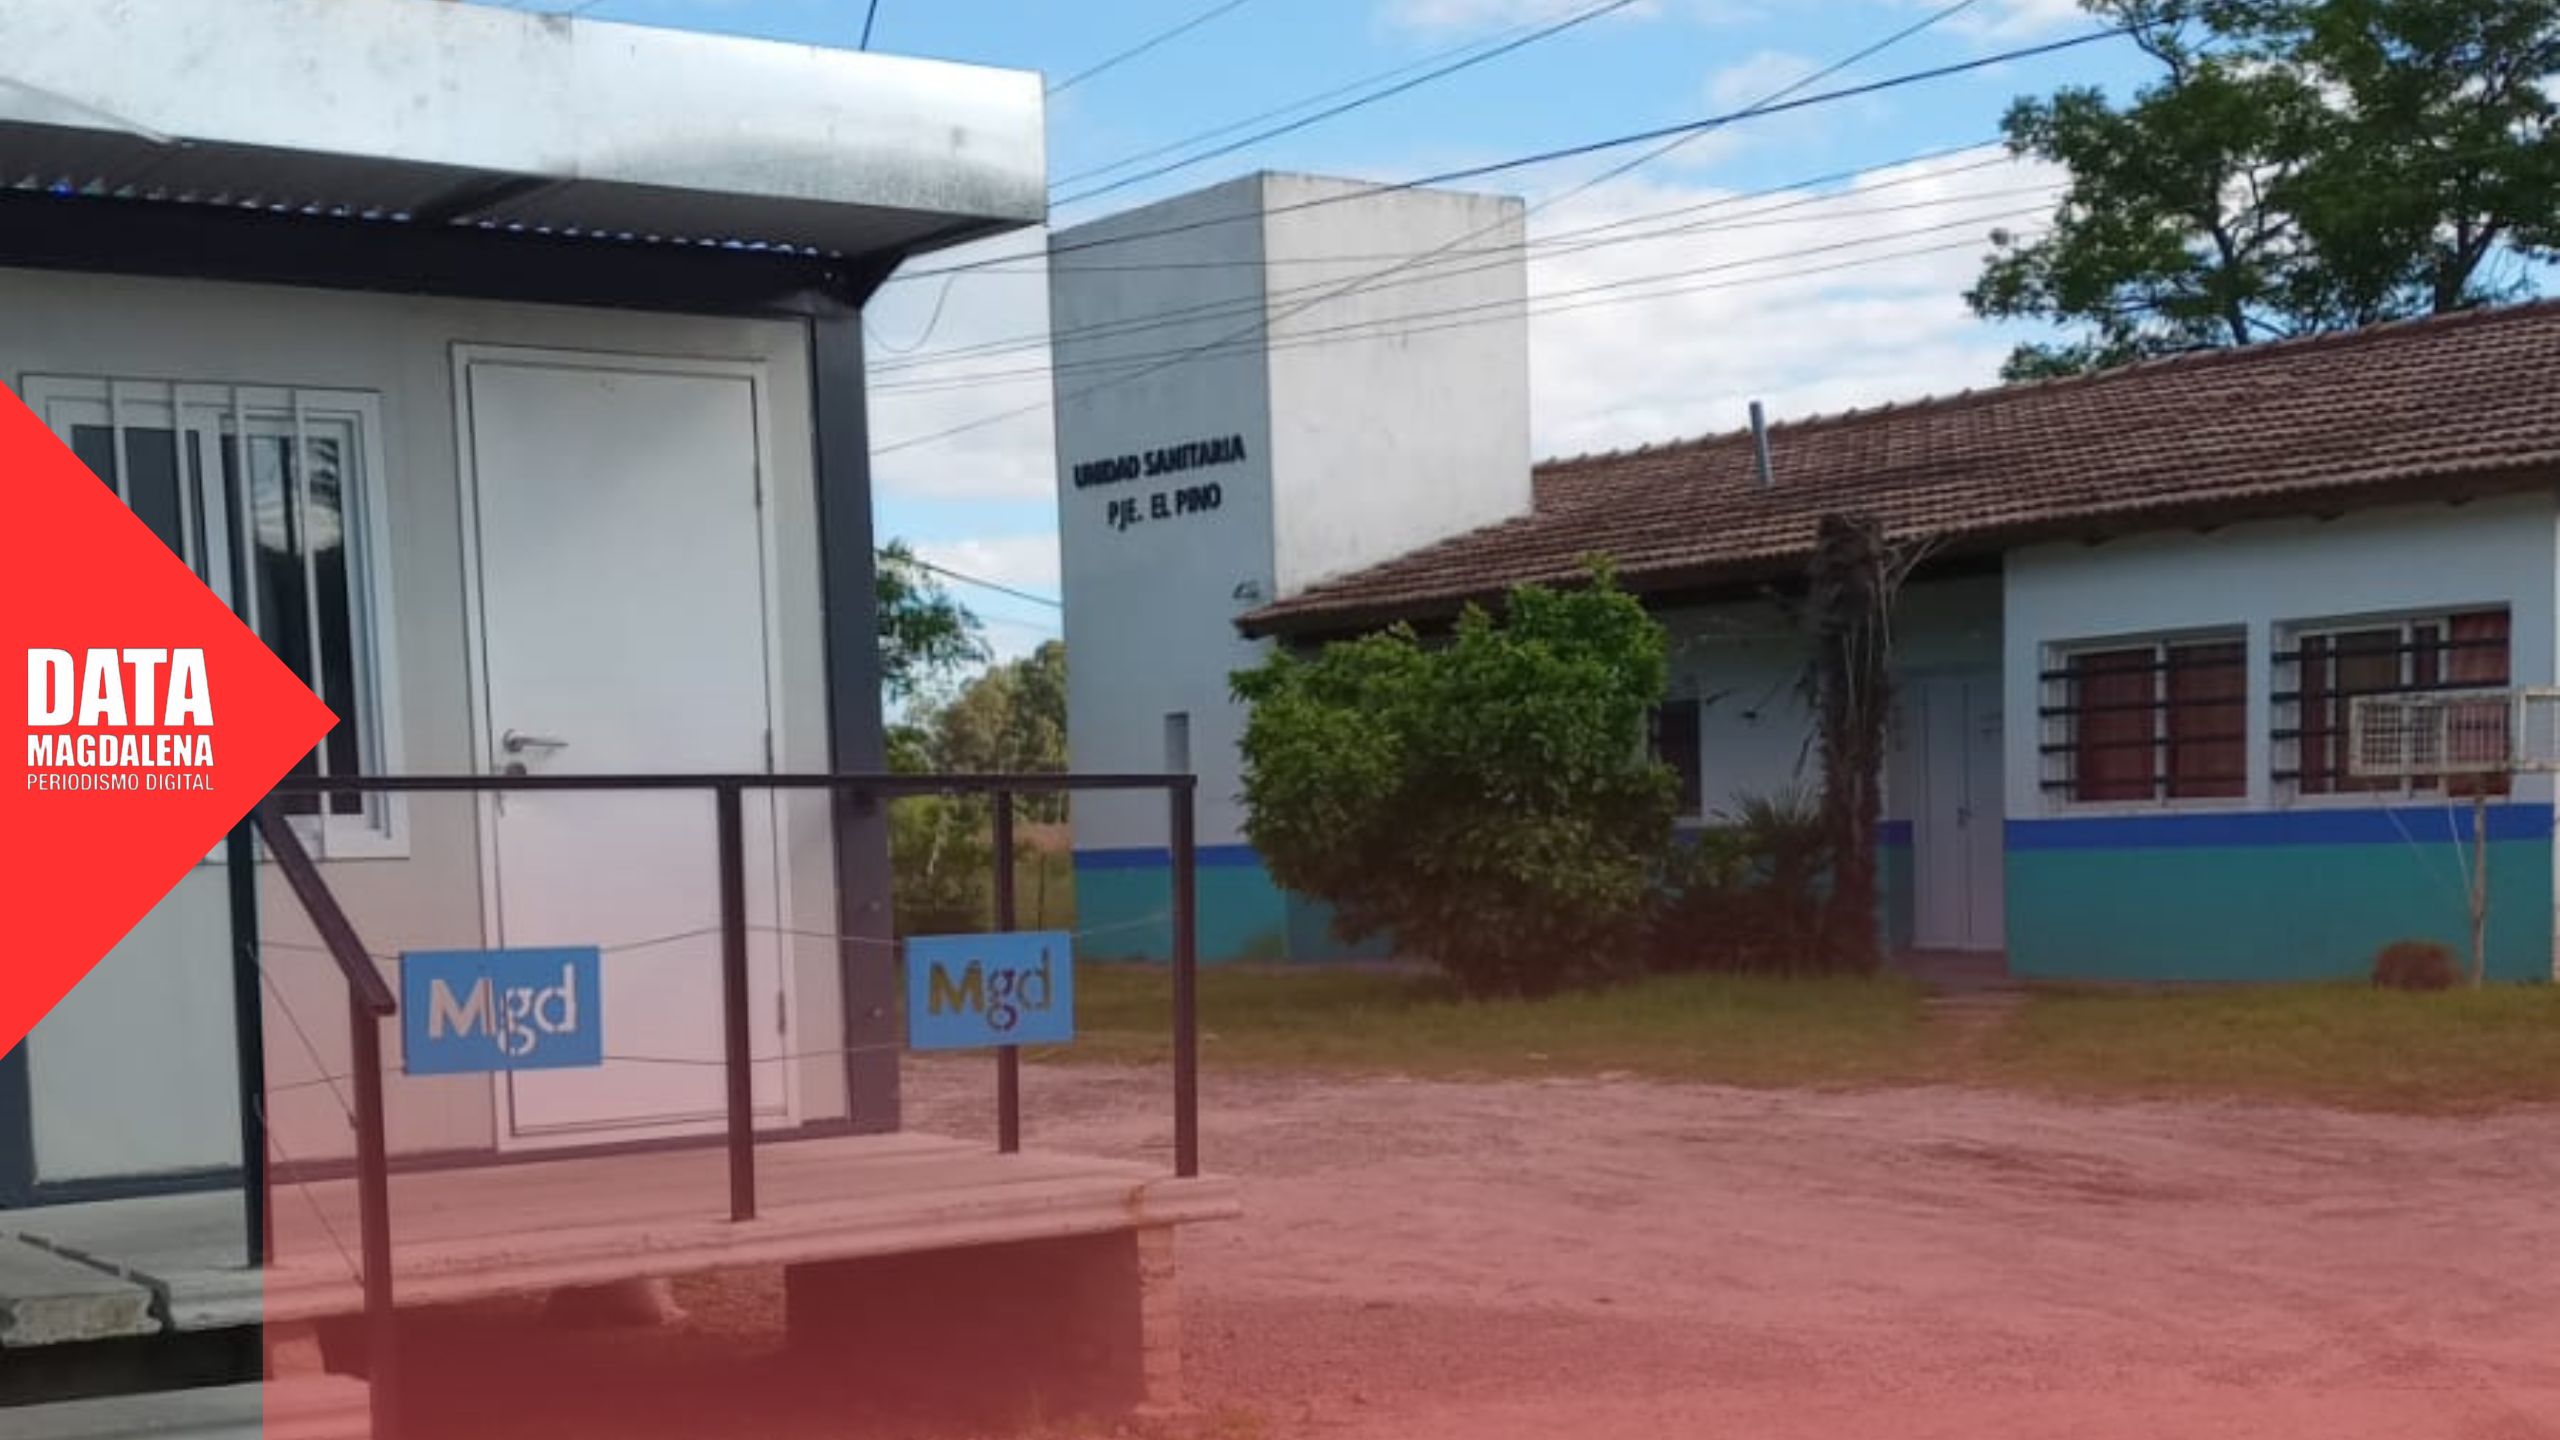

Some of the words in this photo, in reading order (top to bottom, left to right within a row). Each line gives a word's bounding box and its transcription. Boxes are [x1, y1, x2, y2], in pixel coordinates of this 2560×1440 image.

[1073, 454, 1140, 489] UNIDAD
[1143, 433, 1246, 477] SANITARIA
[1151, 492, 1171, 519] EL
[1175, 482, 1221, 515] PINO
[428, 963, 578, 1057] Mgd
[928, 947, 1052, 1031] Mgd
